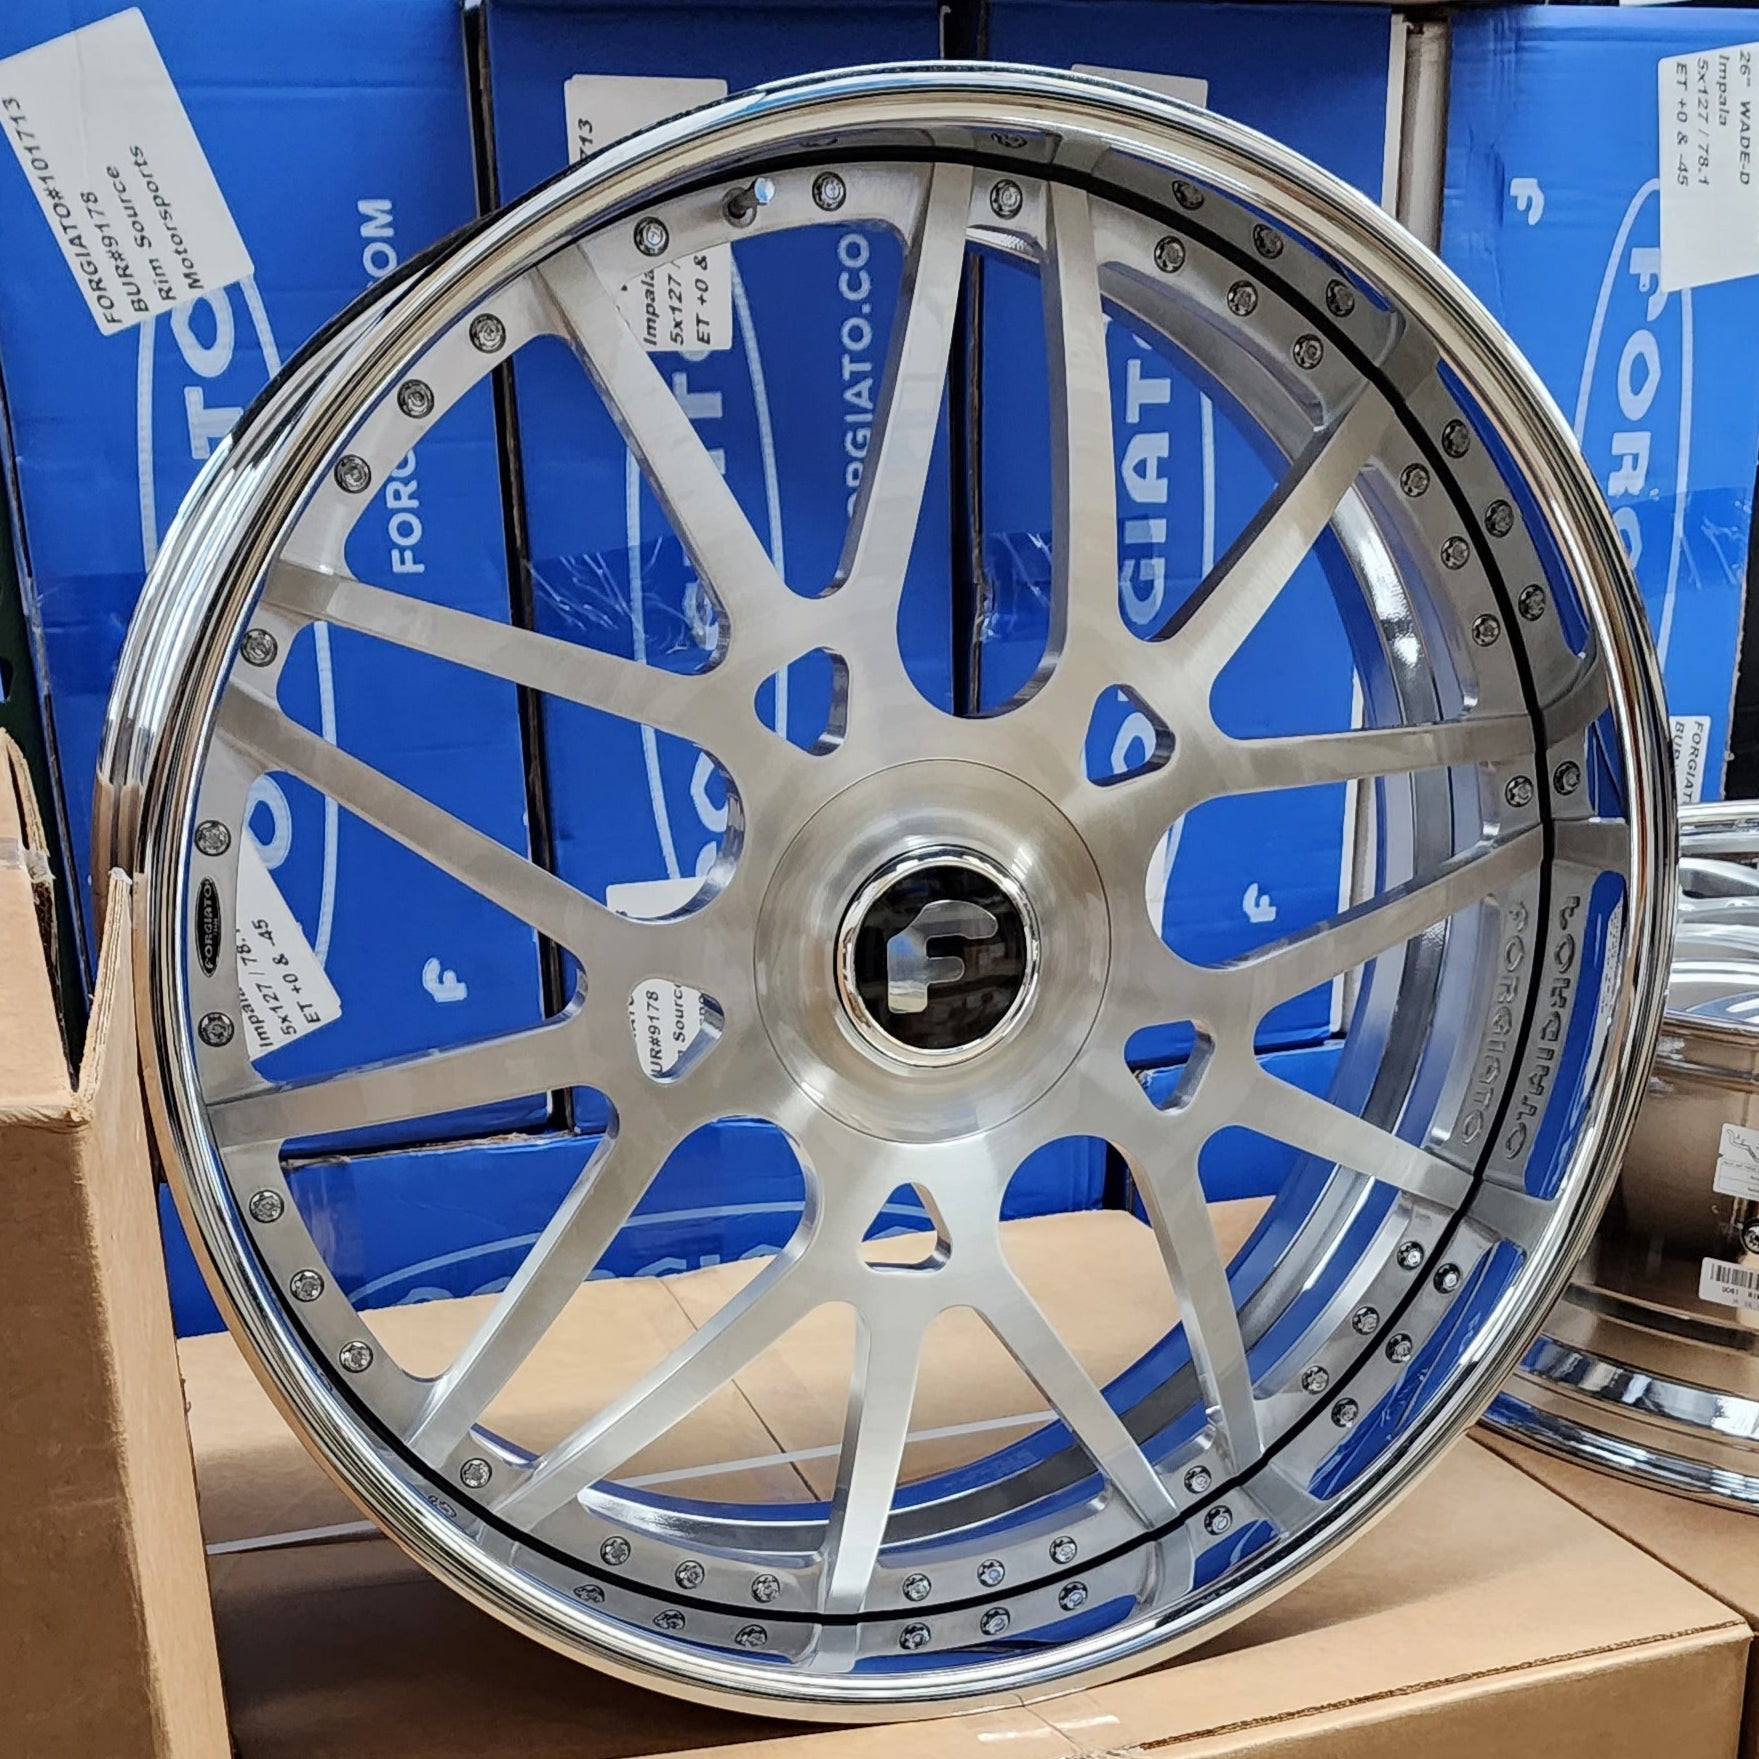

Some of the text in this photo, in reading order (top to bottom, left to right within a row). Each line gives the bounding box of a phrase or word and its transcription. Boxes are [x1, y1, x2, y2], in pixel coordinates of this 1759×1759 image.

[1676, 62, 1688, 187] ET +0 & -45
[1697, 58, 1709, 124] 5x127
[1716, 54, 1730, 127] Impala
[1697, 143, 1710, 186] 78.1
[1739, 101, 1751, 186] WADE-D
[2, 97, 123, 324] FORGIATO#101713
[81, 191, 149, 312] BUR#9178
[107, 166, 176, 301] Rim Source
[130, 145, 204, 290] Motorsports
[357, 199, 398, 288] OM
[667, 272, 684, 346] 5x127
[693, 255, 711, 345] ET +0 &
[1682, 720, 1705, 804] FORGIAT
[203, 882, 214, 970] FORGIATO
[251, 919, 322, 1024] ET +0 & -45
[255, 982, 297, 1036] 5x127
[1463, 901, 1528, 1144] FORGIATO
